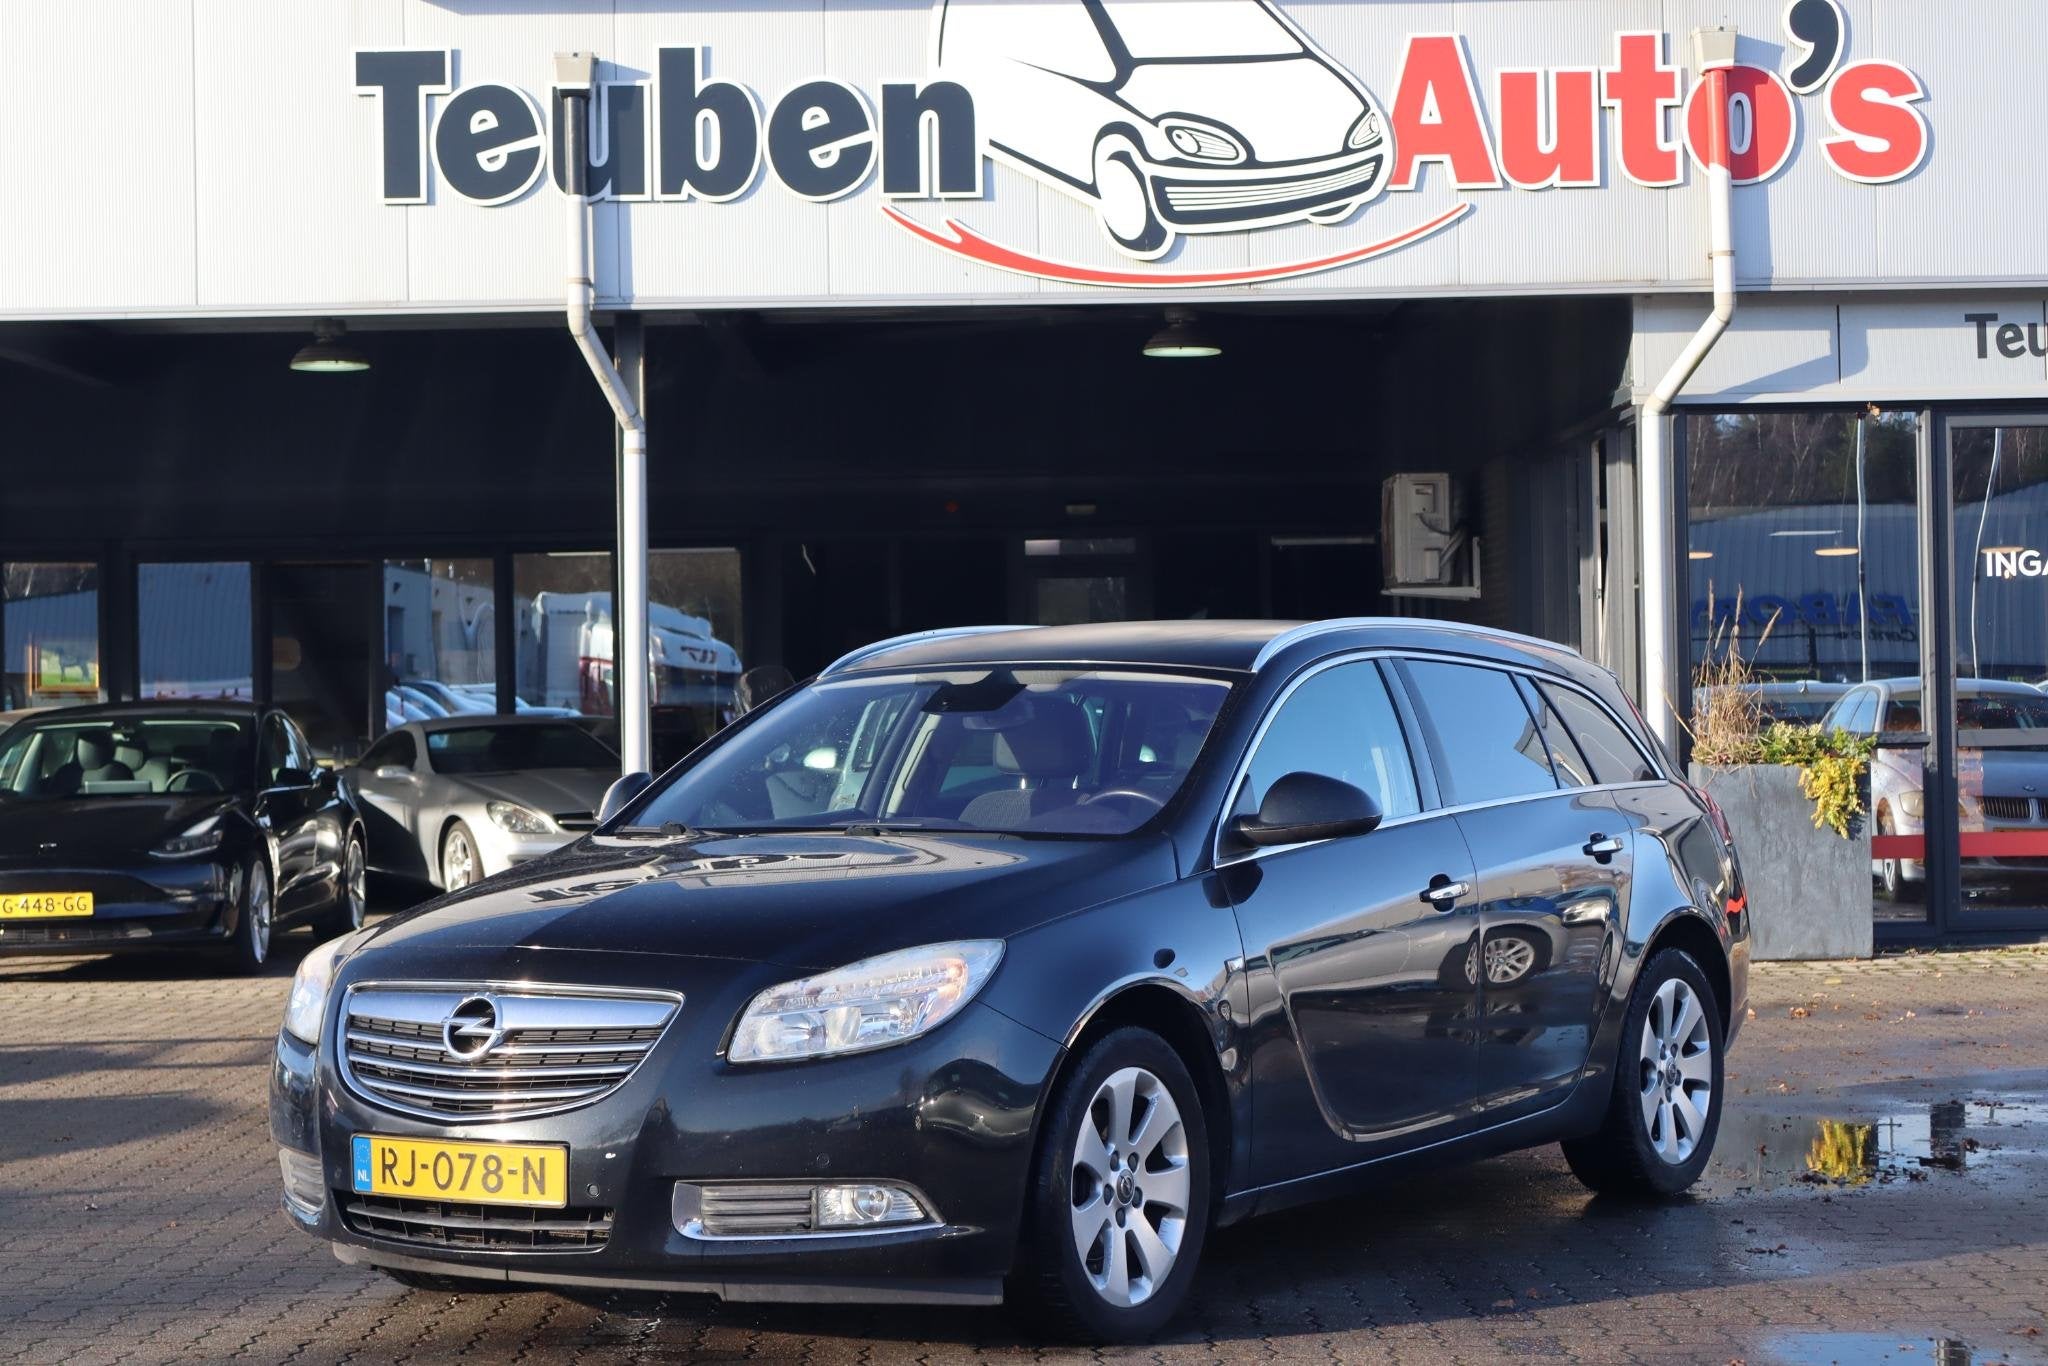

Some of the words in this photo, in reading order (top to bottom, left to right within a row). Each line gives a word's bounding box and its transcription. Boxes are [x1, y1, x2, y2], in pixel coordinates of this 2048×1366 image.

[354, 46, 979, 201] Teuben
[1391, 0, 1924, 186] Auto's
[1986, 549, 2048, 577] ING
[357, 1168, 370, 1182] NL
[380, 1146, 547, 1196] RJ-078-N
